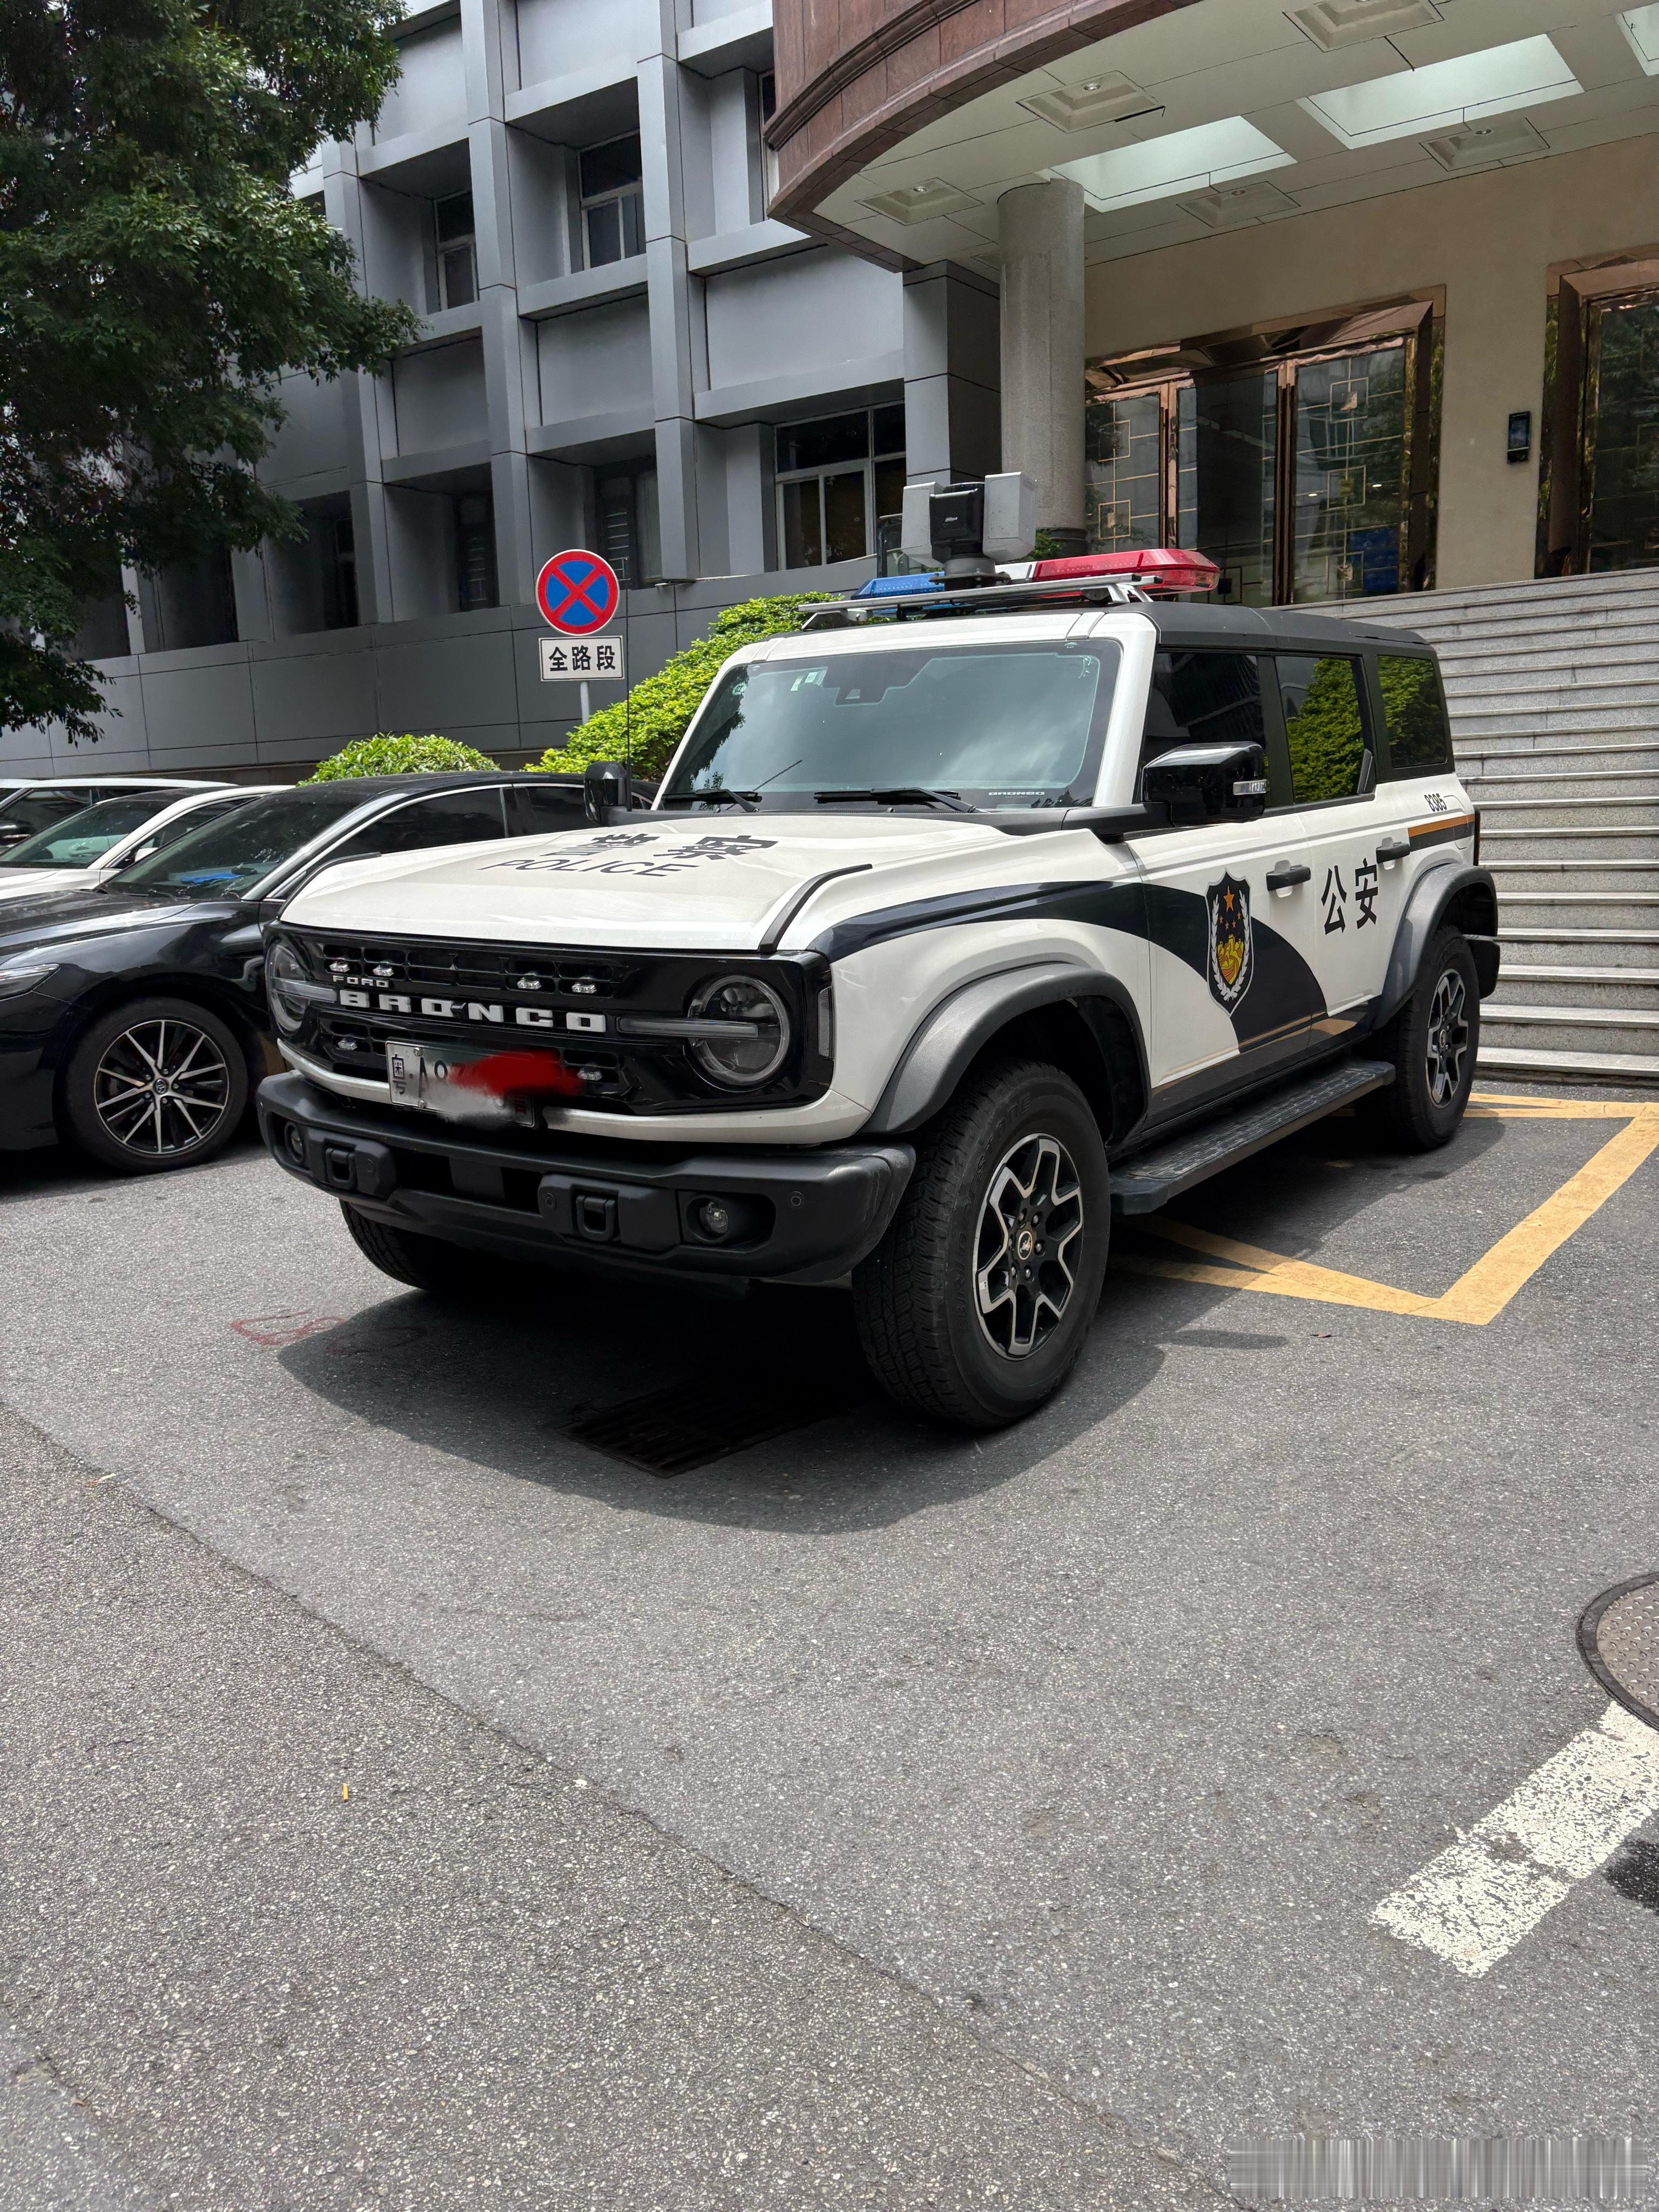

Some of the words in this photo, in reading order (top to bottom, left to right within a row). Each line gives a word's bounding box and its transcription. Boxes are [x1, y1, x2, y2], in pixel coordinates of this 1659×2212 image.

[548, 645, 616, 671] 全路段
[1424, 793, 1447, 812] 8385
[539, 833, 779, 860] 警察
[476, 859, 700, 877] POLICE
[1321, 858, 1378, 935] 公安
[333, 975, 389, 988] FORD
[340, 989, 606, 1033] BRONCO
